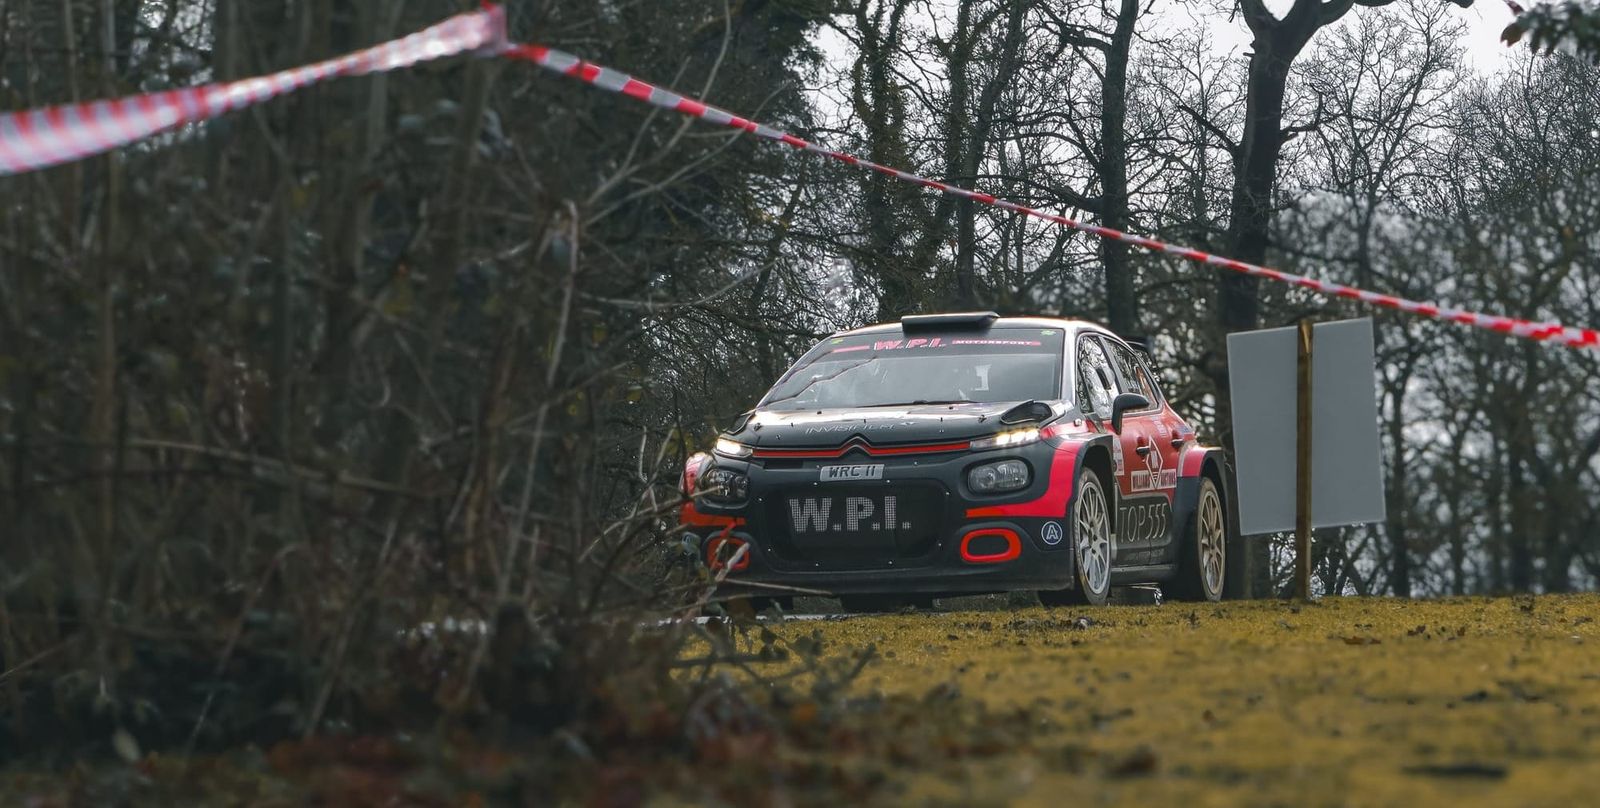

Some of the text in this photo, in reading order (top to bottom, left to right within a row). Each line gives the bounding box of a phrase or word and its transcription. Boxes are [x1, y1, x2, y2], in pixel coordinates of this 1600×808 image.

[829, 465, 860, 478] WRC
[789, 495, 912, 532] W.P.I.
[1119, 502, 1168, 542] TOP555
